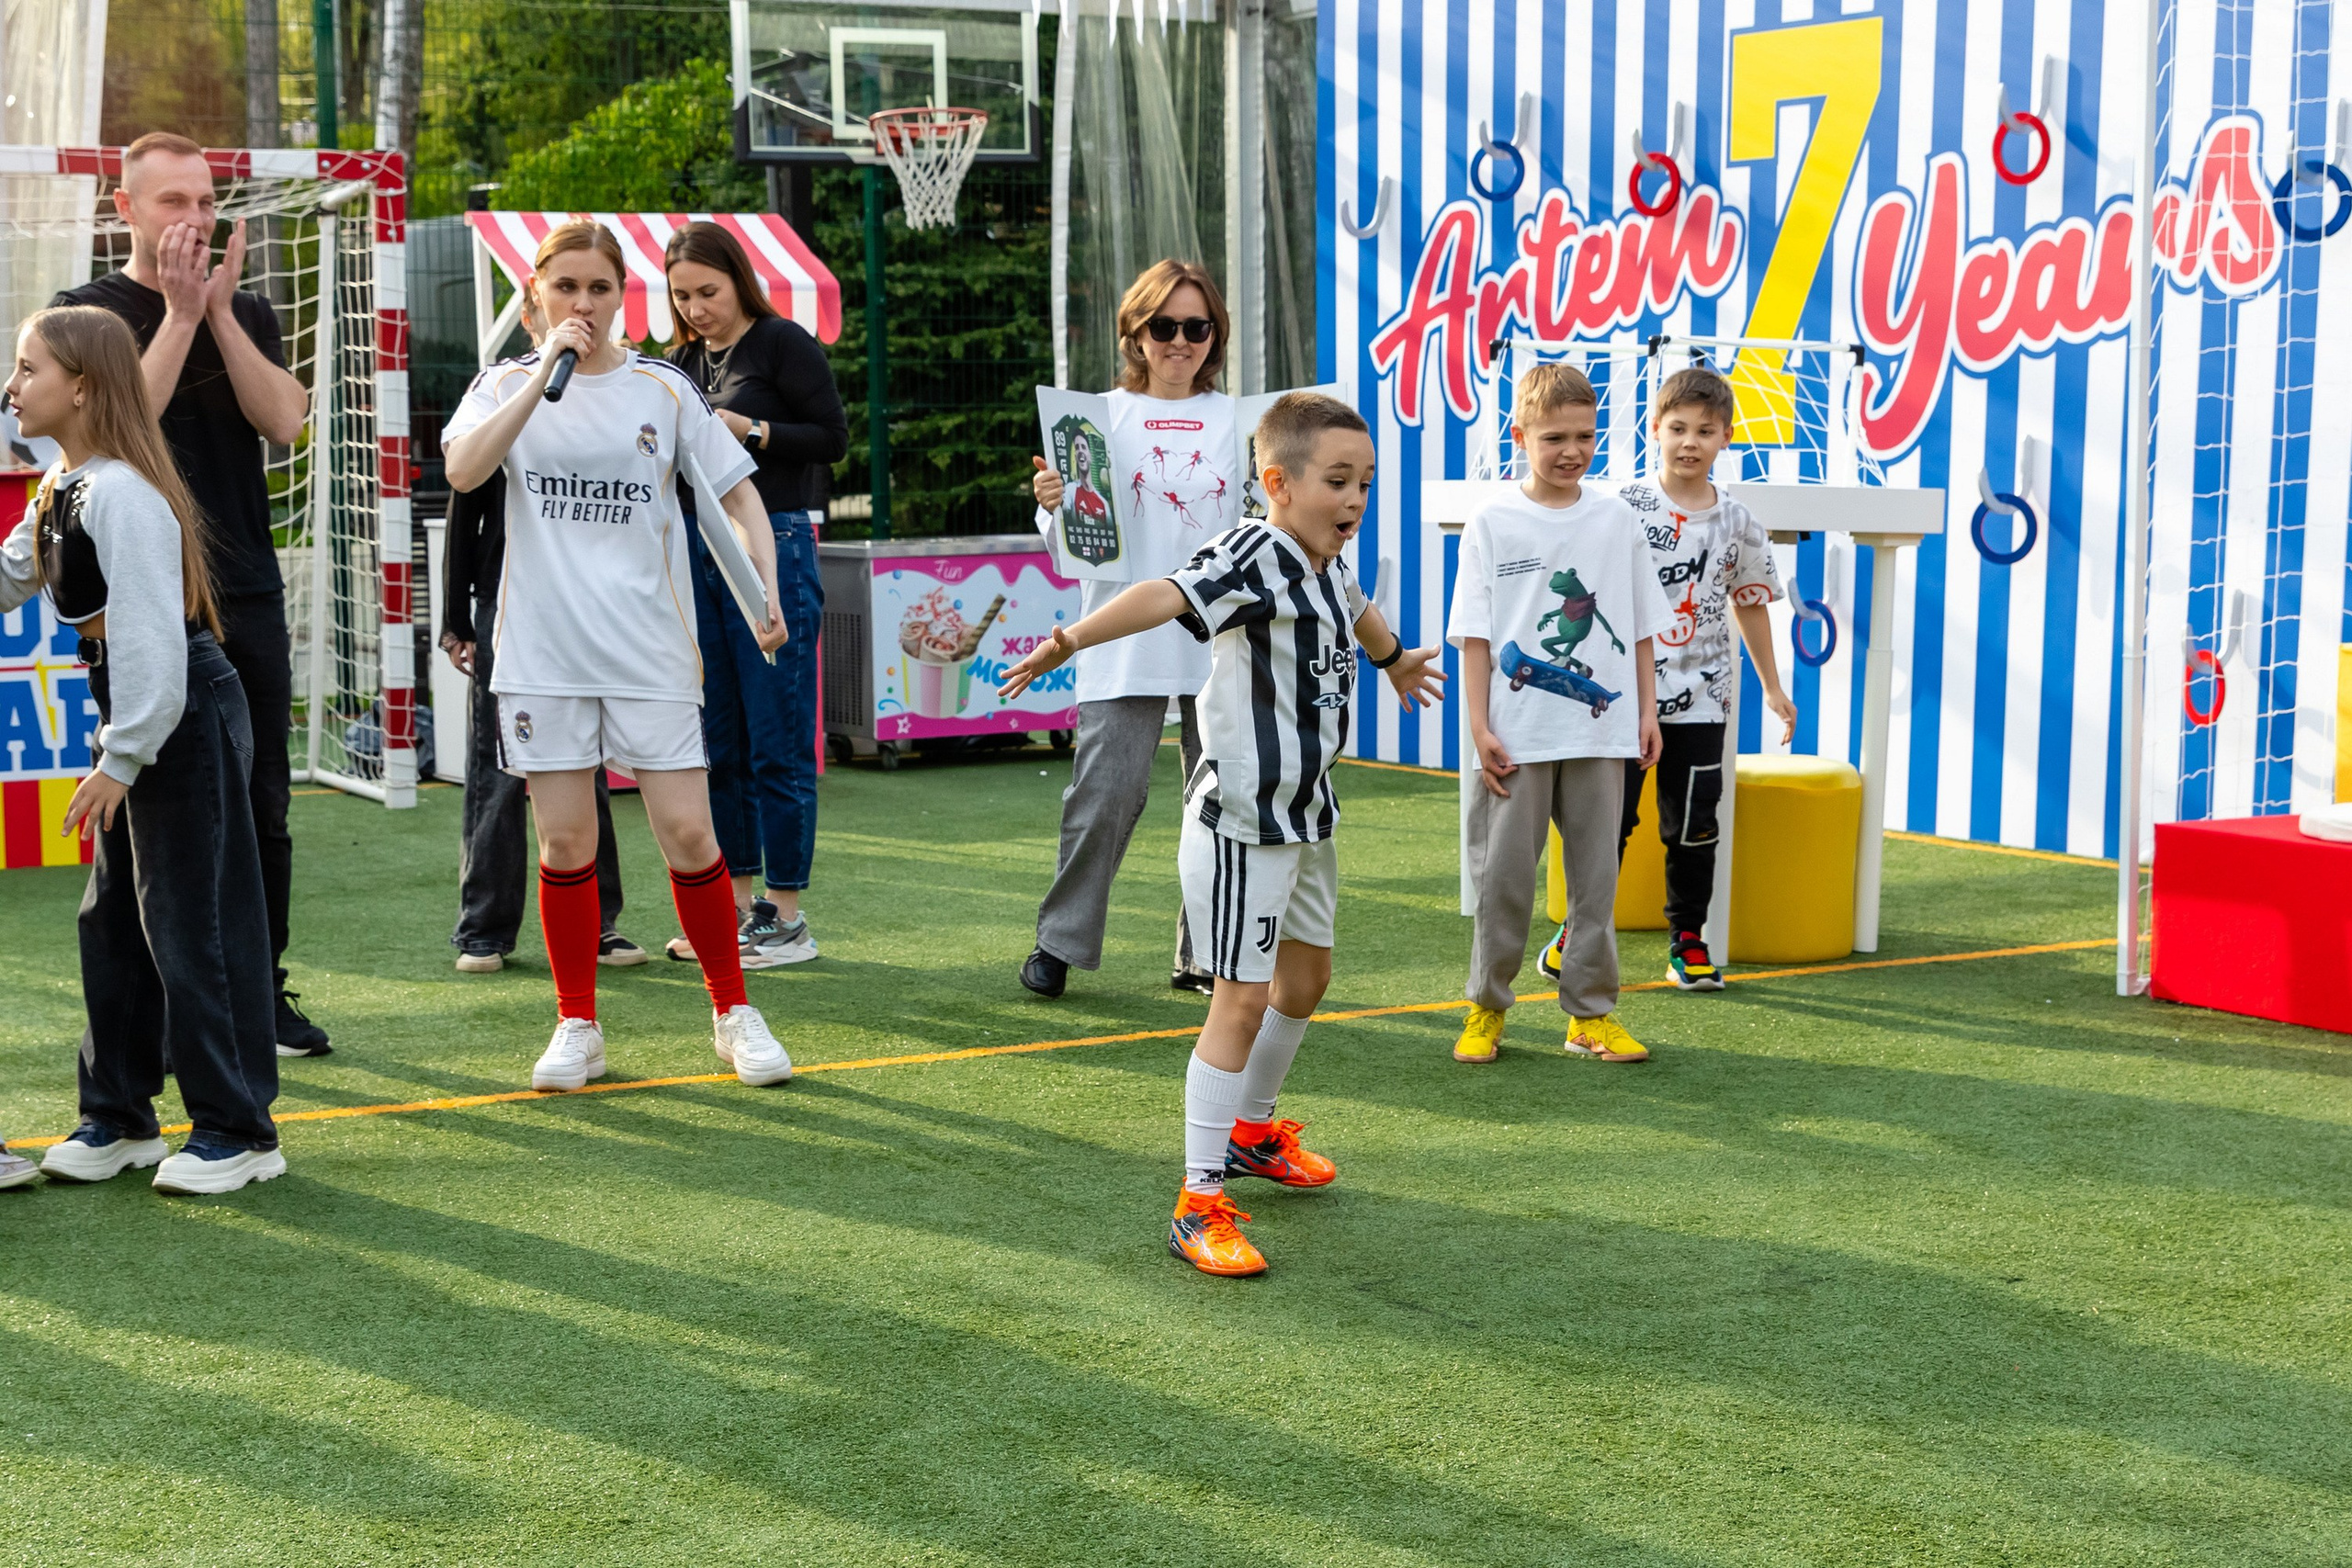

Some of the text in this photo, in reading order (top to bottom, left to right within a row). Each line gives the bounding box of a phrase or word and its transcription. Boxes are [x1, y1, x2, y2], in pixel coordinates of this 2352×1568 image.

[1372, 16, 2278, 456] Artem 7 Years
[1054, 430, 1066, 447] 89
[1158, 421, 1201, 430] OLIMPBET
[525, 468, 652, 503] Emirates
[541, 500, 632, 525] FLY BETTER
[1641, 518, 1681, 551] OUTH
